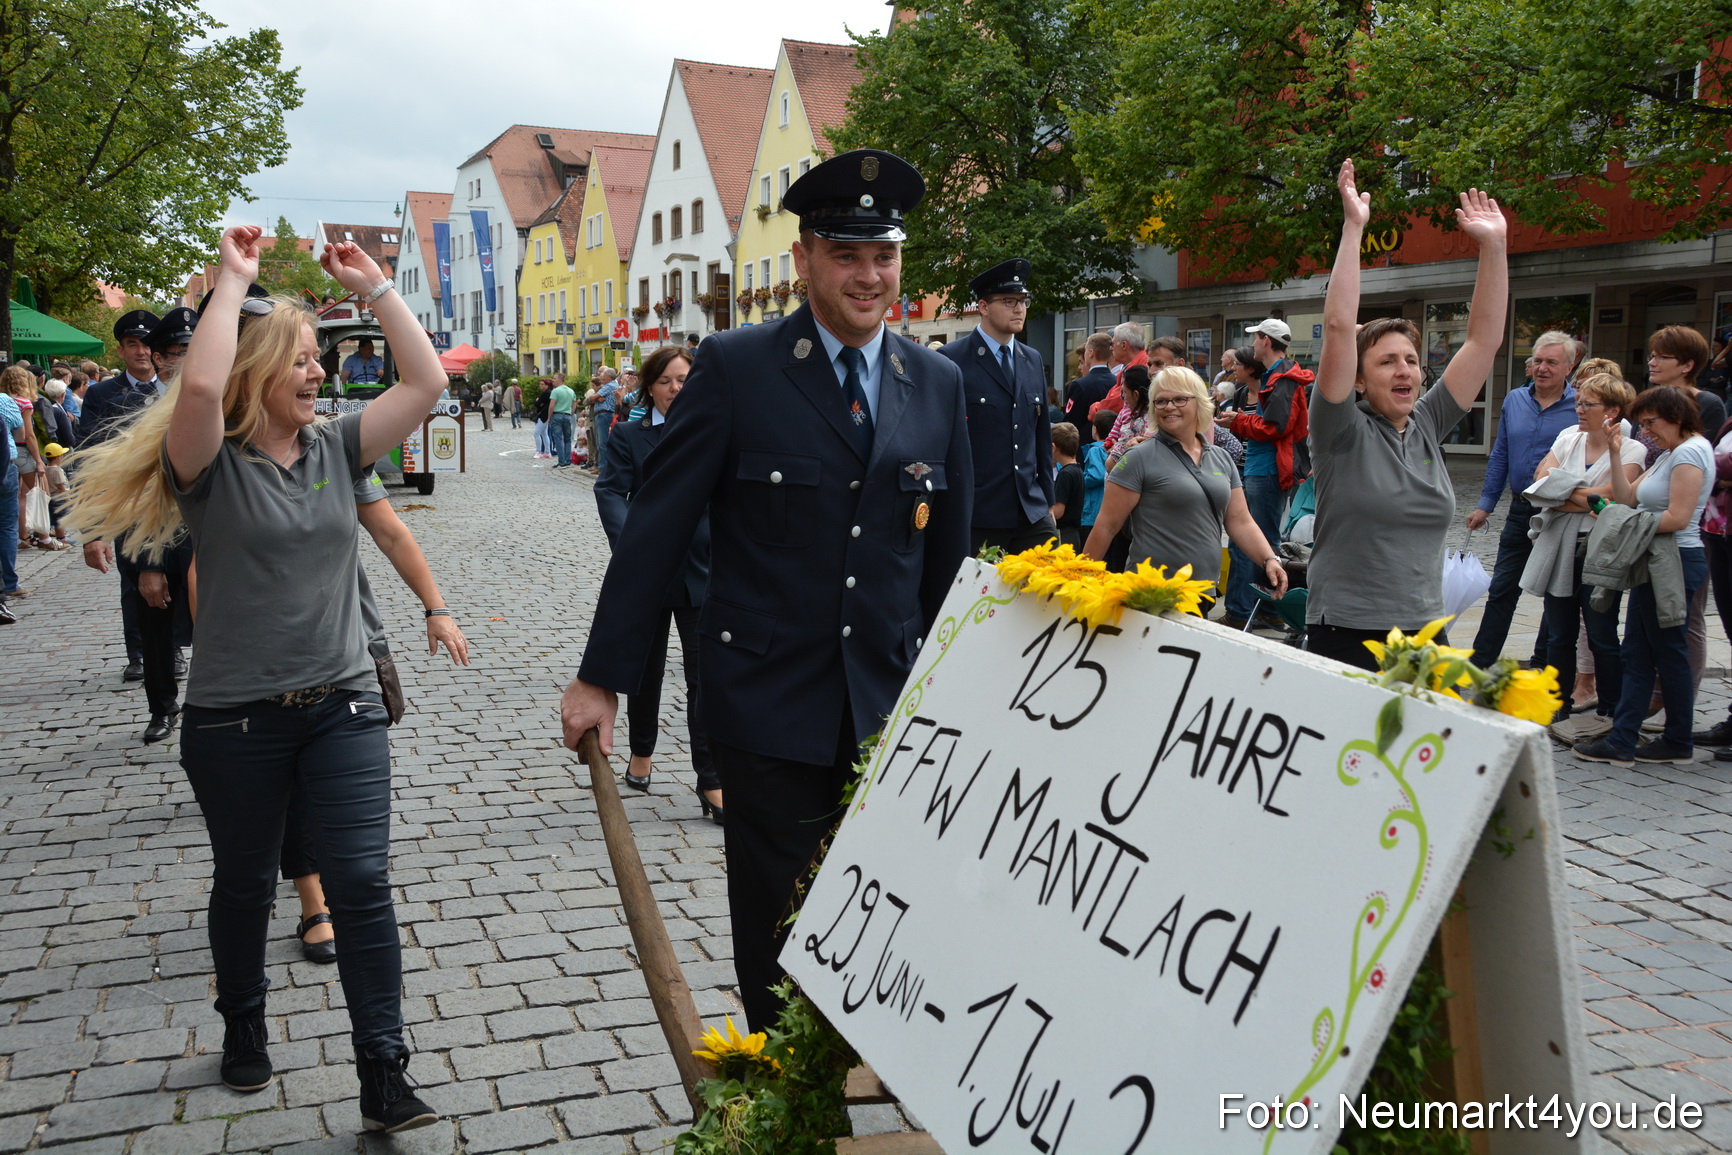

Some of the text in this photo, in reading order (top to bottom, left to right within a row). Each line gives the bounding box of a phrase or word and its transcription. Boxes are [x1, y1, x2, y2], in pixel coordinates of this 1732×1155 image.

[541, 276, 555, 289] HOTEL
[1008, 606, 1326, 825] 125 JAHRE
[878, 716, 1281, 1027] FFW MANTLACH
